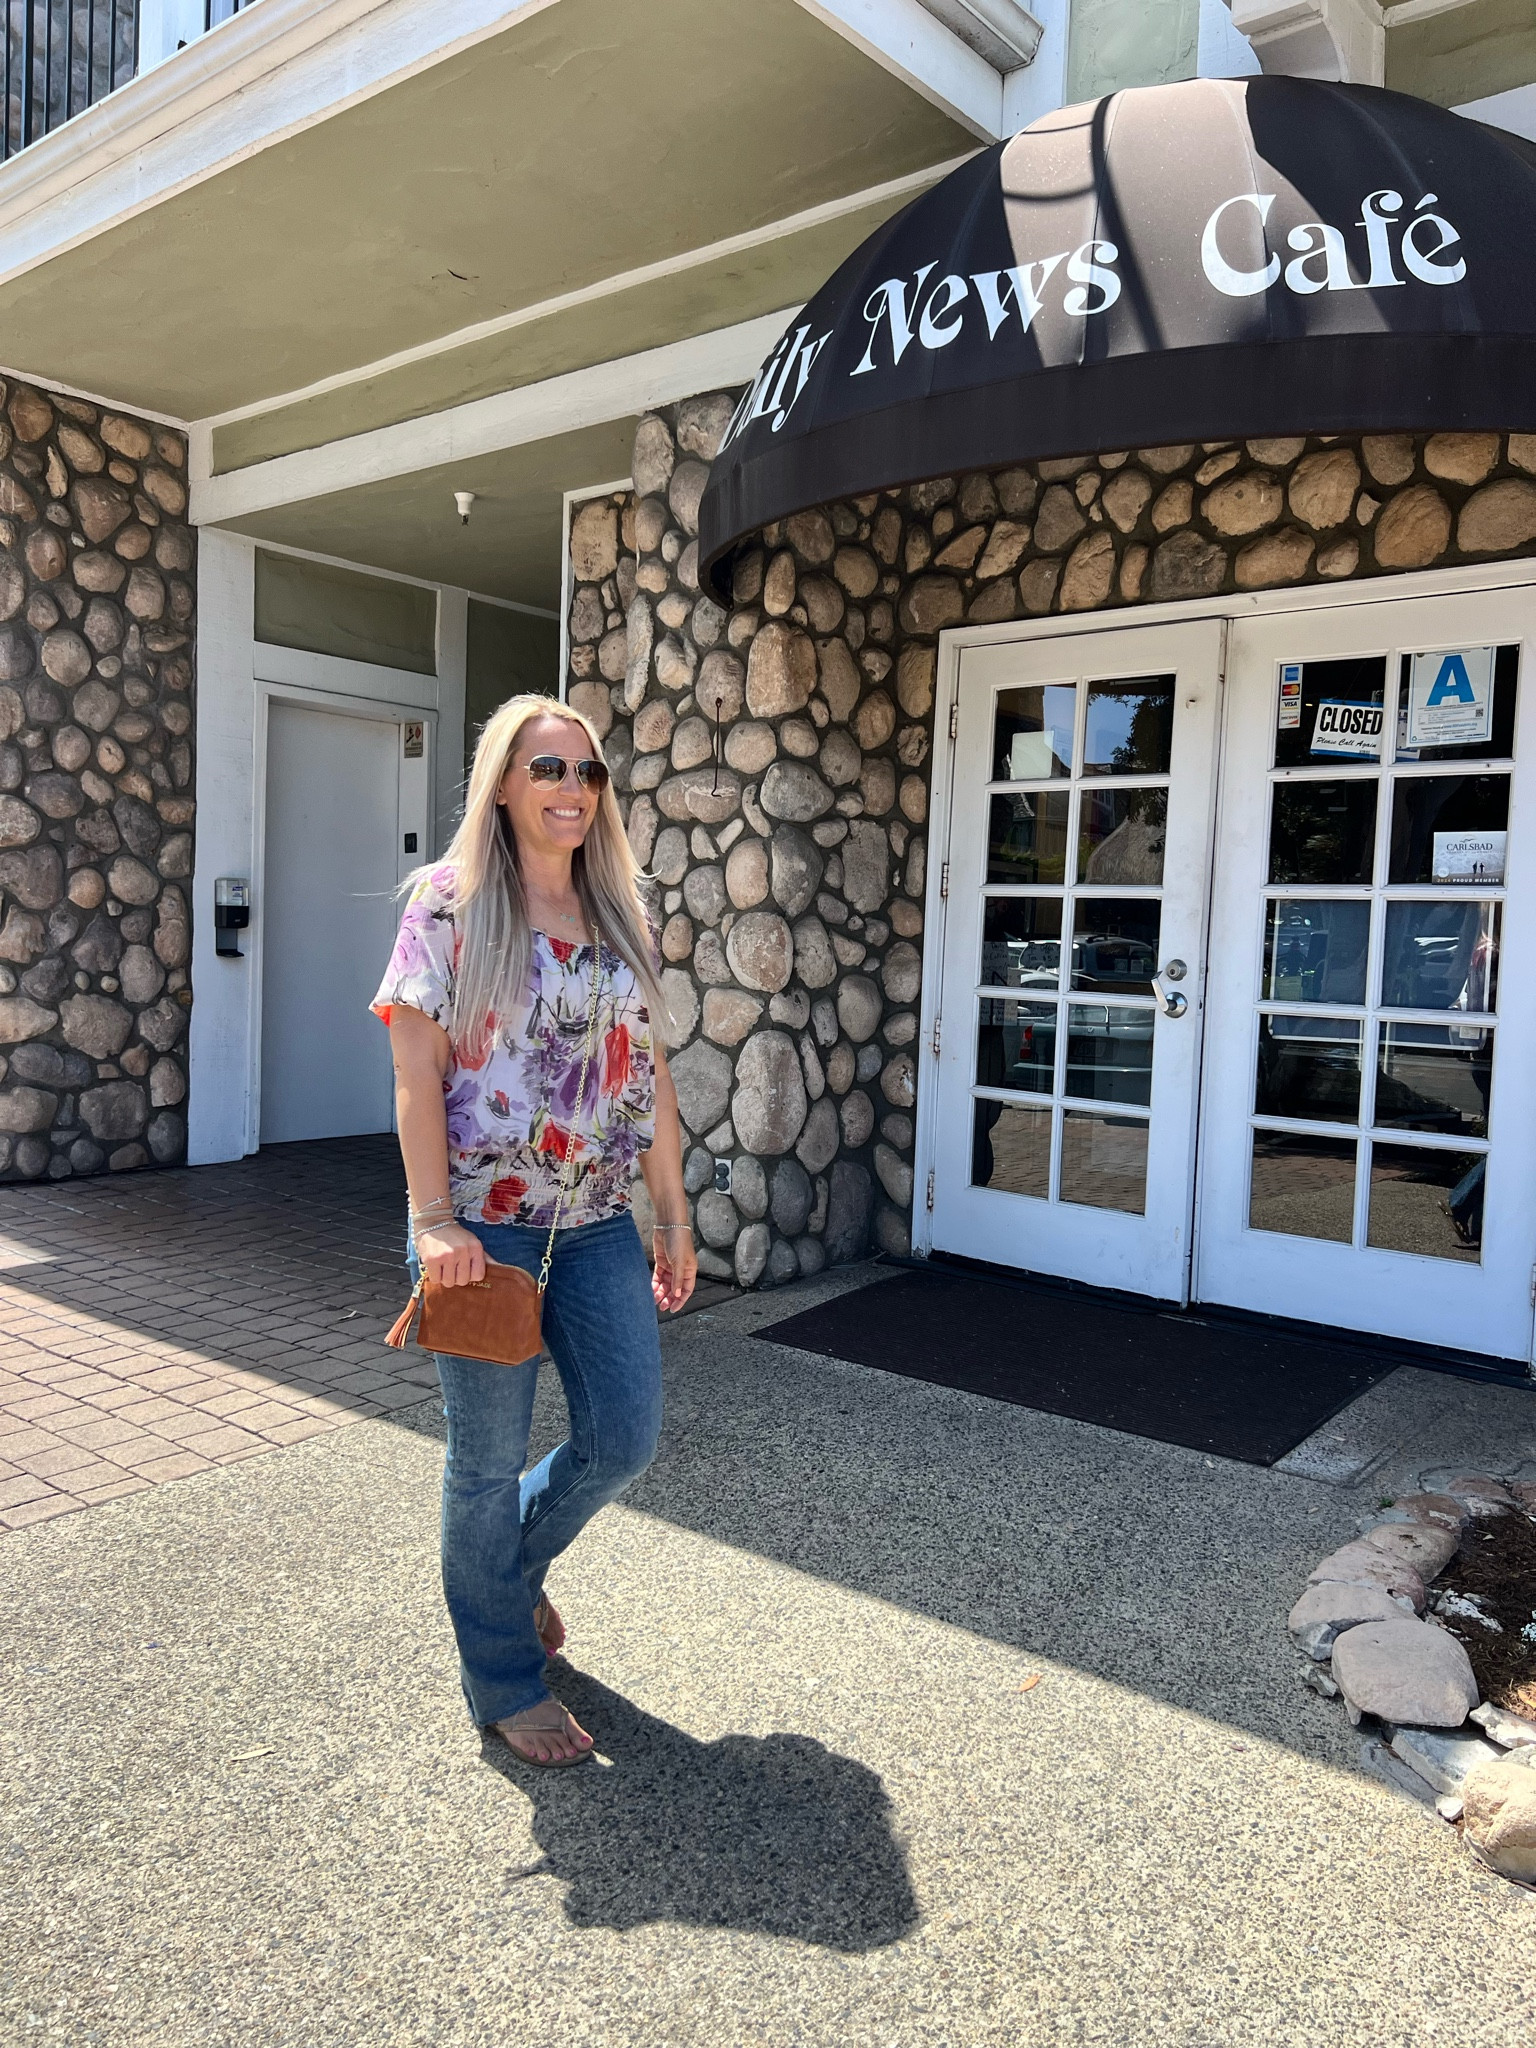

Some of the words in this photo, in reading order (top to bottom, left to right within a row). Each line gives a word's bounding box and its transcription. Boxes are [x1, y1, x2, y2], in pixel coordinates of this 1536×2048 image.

[850, 239, 1122, 376] News
[1201, 189, 1467, 297] Café
[1425, 654, 1475, 706] A
[1319, 706, 1384, 736] CLOSED
[1316, 736, 1337, 746] Please
[1338, 738, 1354, 747] Call
[1355, 740, 1377, 749] Again
[1446, 843, 1493, 851] CARLSBAD
